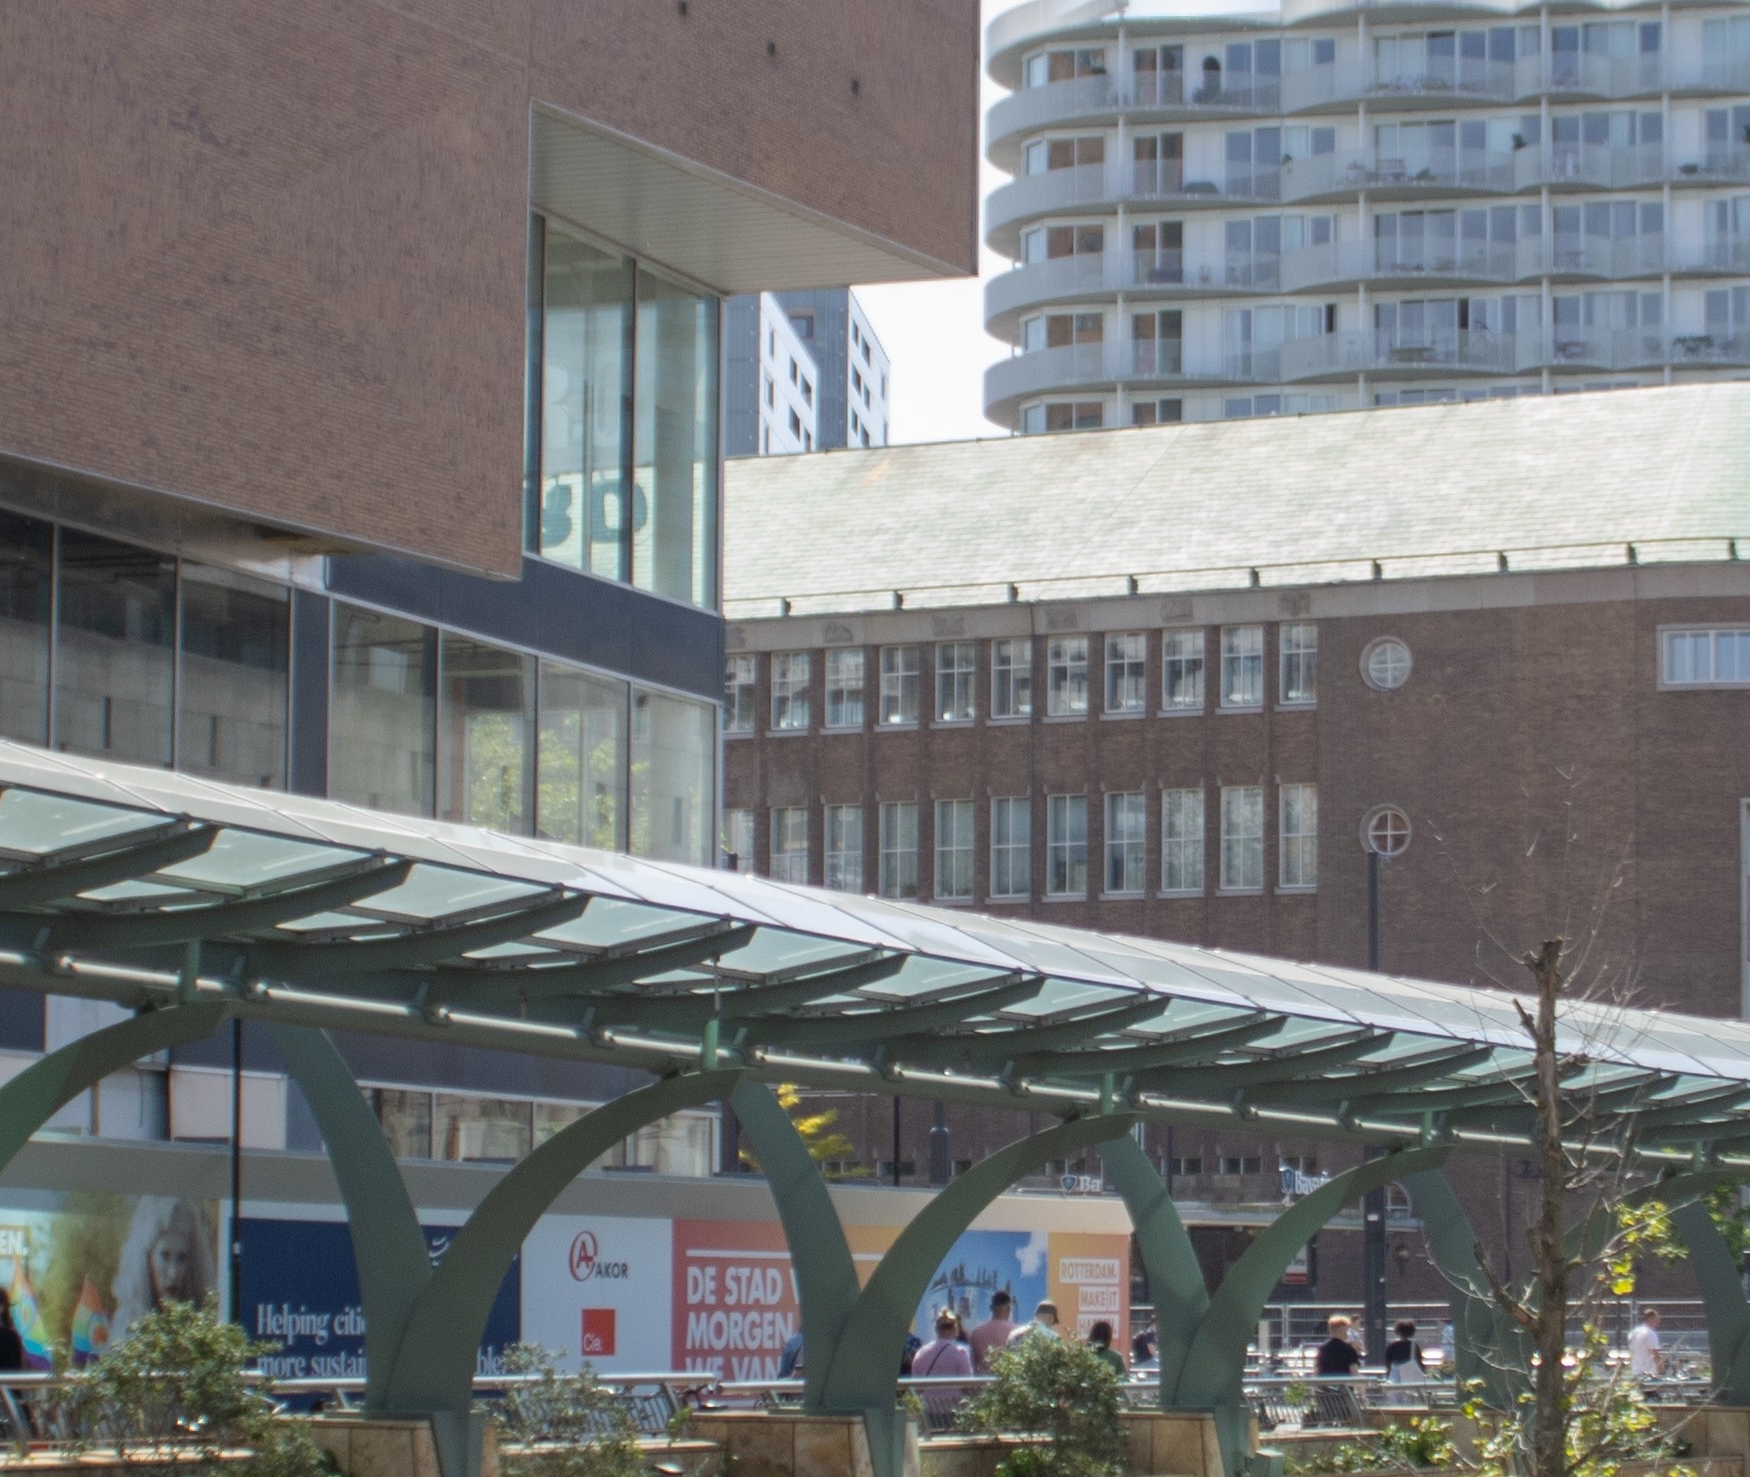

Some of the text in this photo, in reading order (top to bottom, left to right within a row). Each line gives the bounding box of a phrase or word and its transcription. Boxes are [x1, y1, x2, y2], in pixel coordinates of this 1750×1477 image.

[595, 1261, 629, 1280] AKOR
[687, 1266, 717, 1304] DE
[724, 1266, 782, 1305] STAD
[257, 1303, 332, 1345] Helping
[686, 1310, 794, 1350] MORGEN
